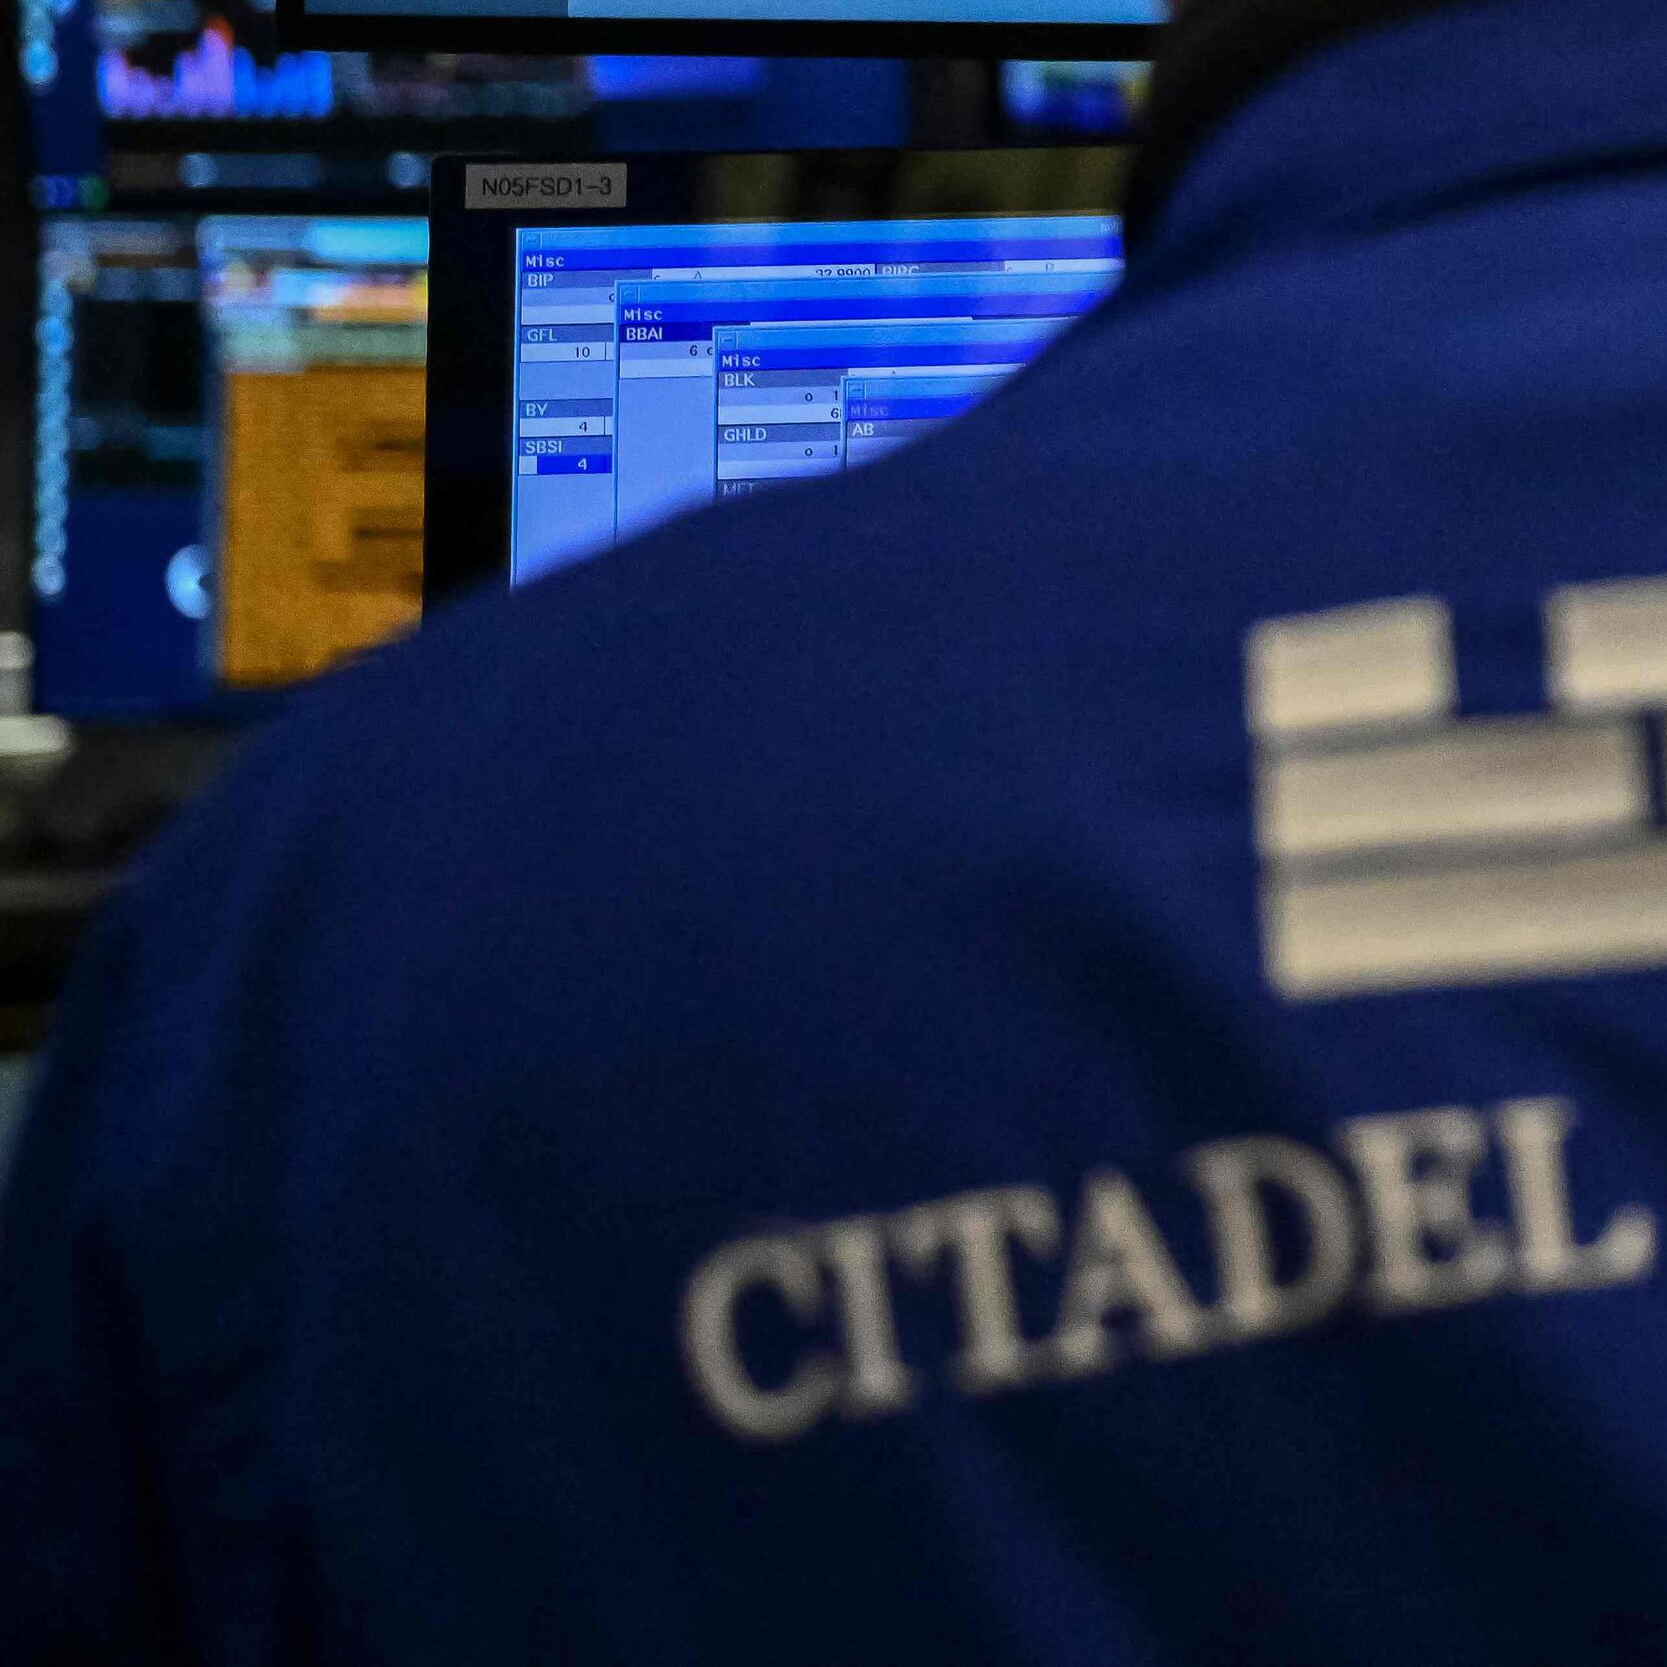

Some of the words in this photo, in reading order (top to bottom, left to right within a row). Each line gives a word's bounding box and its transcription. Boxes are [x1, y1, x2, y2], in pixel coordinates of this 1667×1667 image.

[526, 254, 565, 268] Misc
[528, 273, 554, 287] BIP
[624, 307, 663, 321] Misc
[528, 328, 558, 342] GFL
[627, 327, 663, 340] BBAI
[722, 353, 760, 367] Misc
[724, 373, 755, 387] BLK
[526, 403, 547, 416] BY
[724, 427, 767, 443] GHLD
[852, 423, 874, 436] AB
[683, 1095, 1657, 1443] CITADEL
